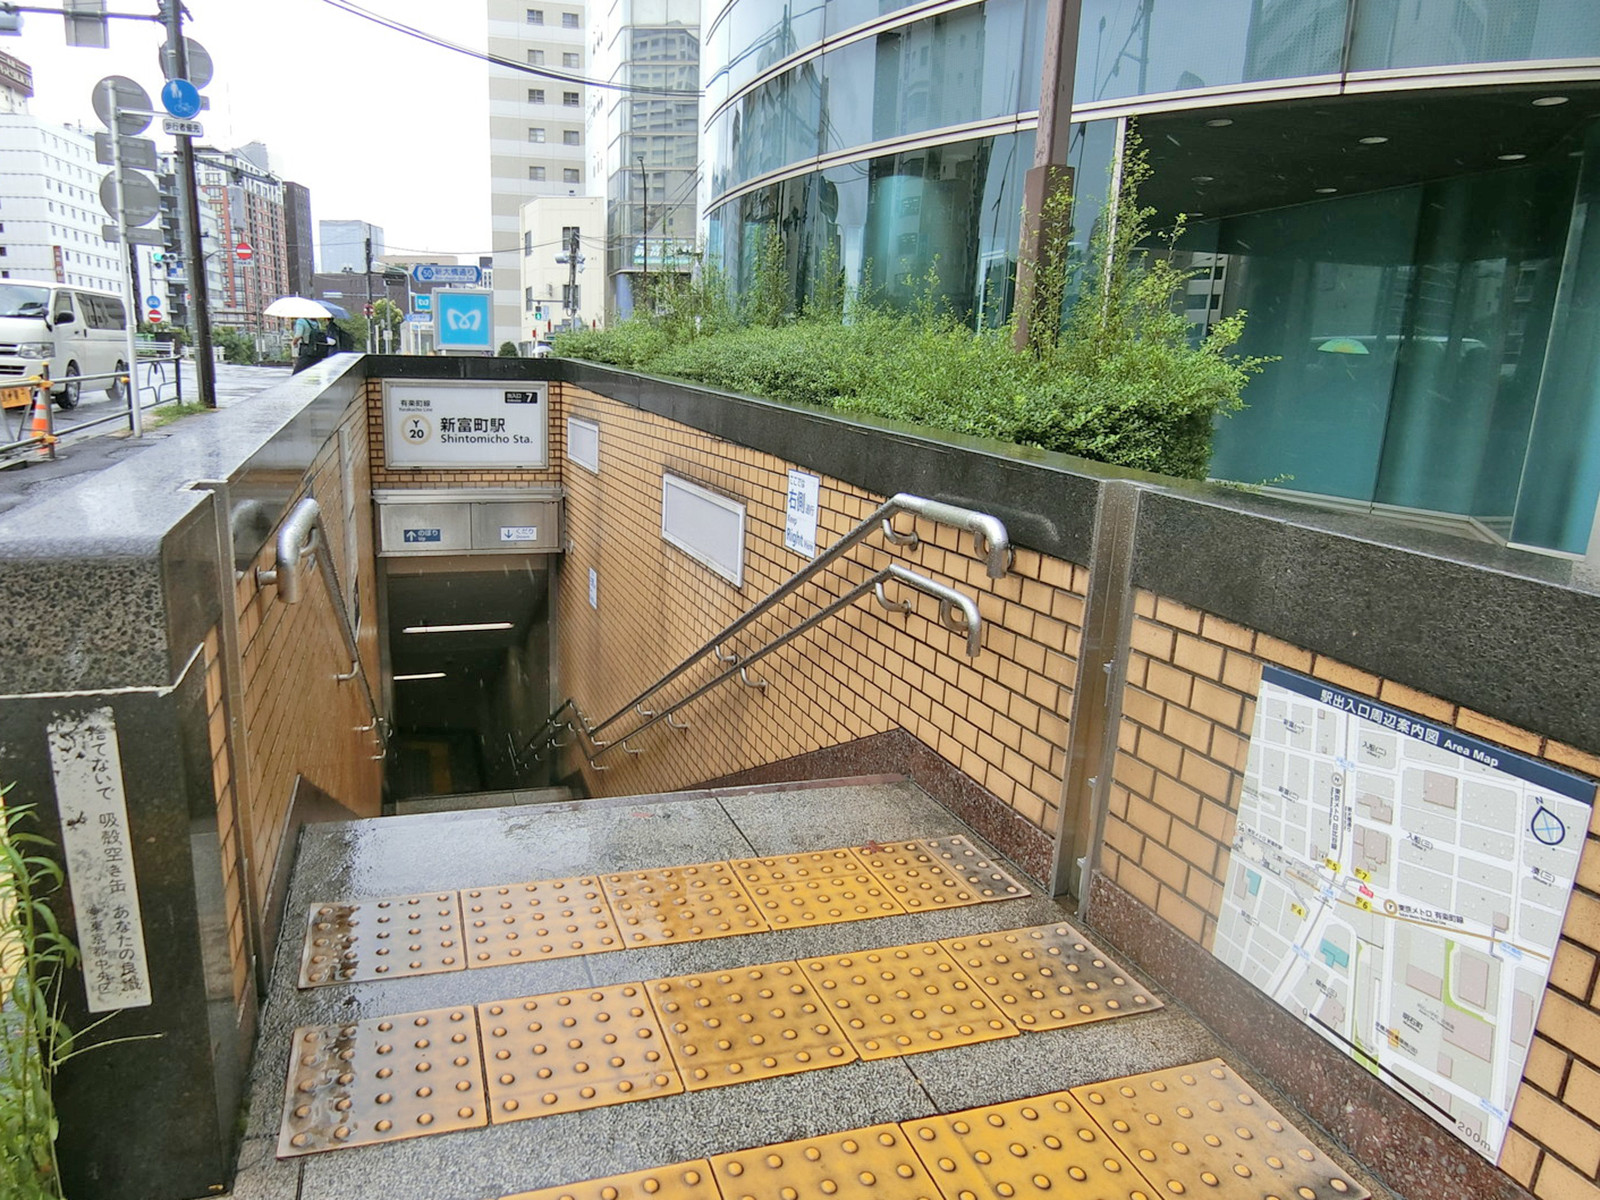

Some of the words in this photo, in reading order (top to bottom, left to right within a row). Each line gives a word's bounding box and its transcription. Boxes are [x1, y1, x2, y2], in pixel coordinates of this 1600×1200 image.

[525, 392, 533, 403] 7
[413, 420, 419, 428] Y
[440, 417, 506, 433] 新富町駅
[409, 429, 424, 439] 20
[440, 433, 510, 444] Shintomicho
[513, 433, 533, 444] Sta.
[787, 528, 804, 547] Right
[1320, 689, 1439, 745] 駅出入口周辺案内図
[1444, 739, 1470, 756] Area
[1473, 749, 1499, 768] Map
[1535, 796, 1544, 805] N
[99, 812, 127, 895] 吸殻空き缶
[1332, 863, 1338, 871] 5
[1361, 872, 1367, 880] 7
[1362, 901, 1368, 910] 6
[1457, 1121, 1491, 1152] 200m
